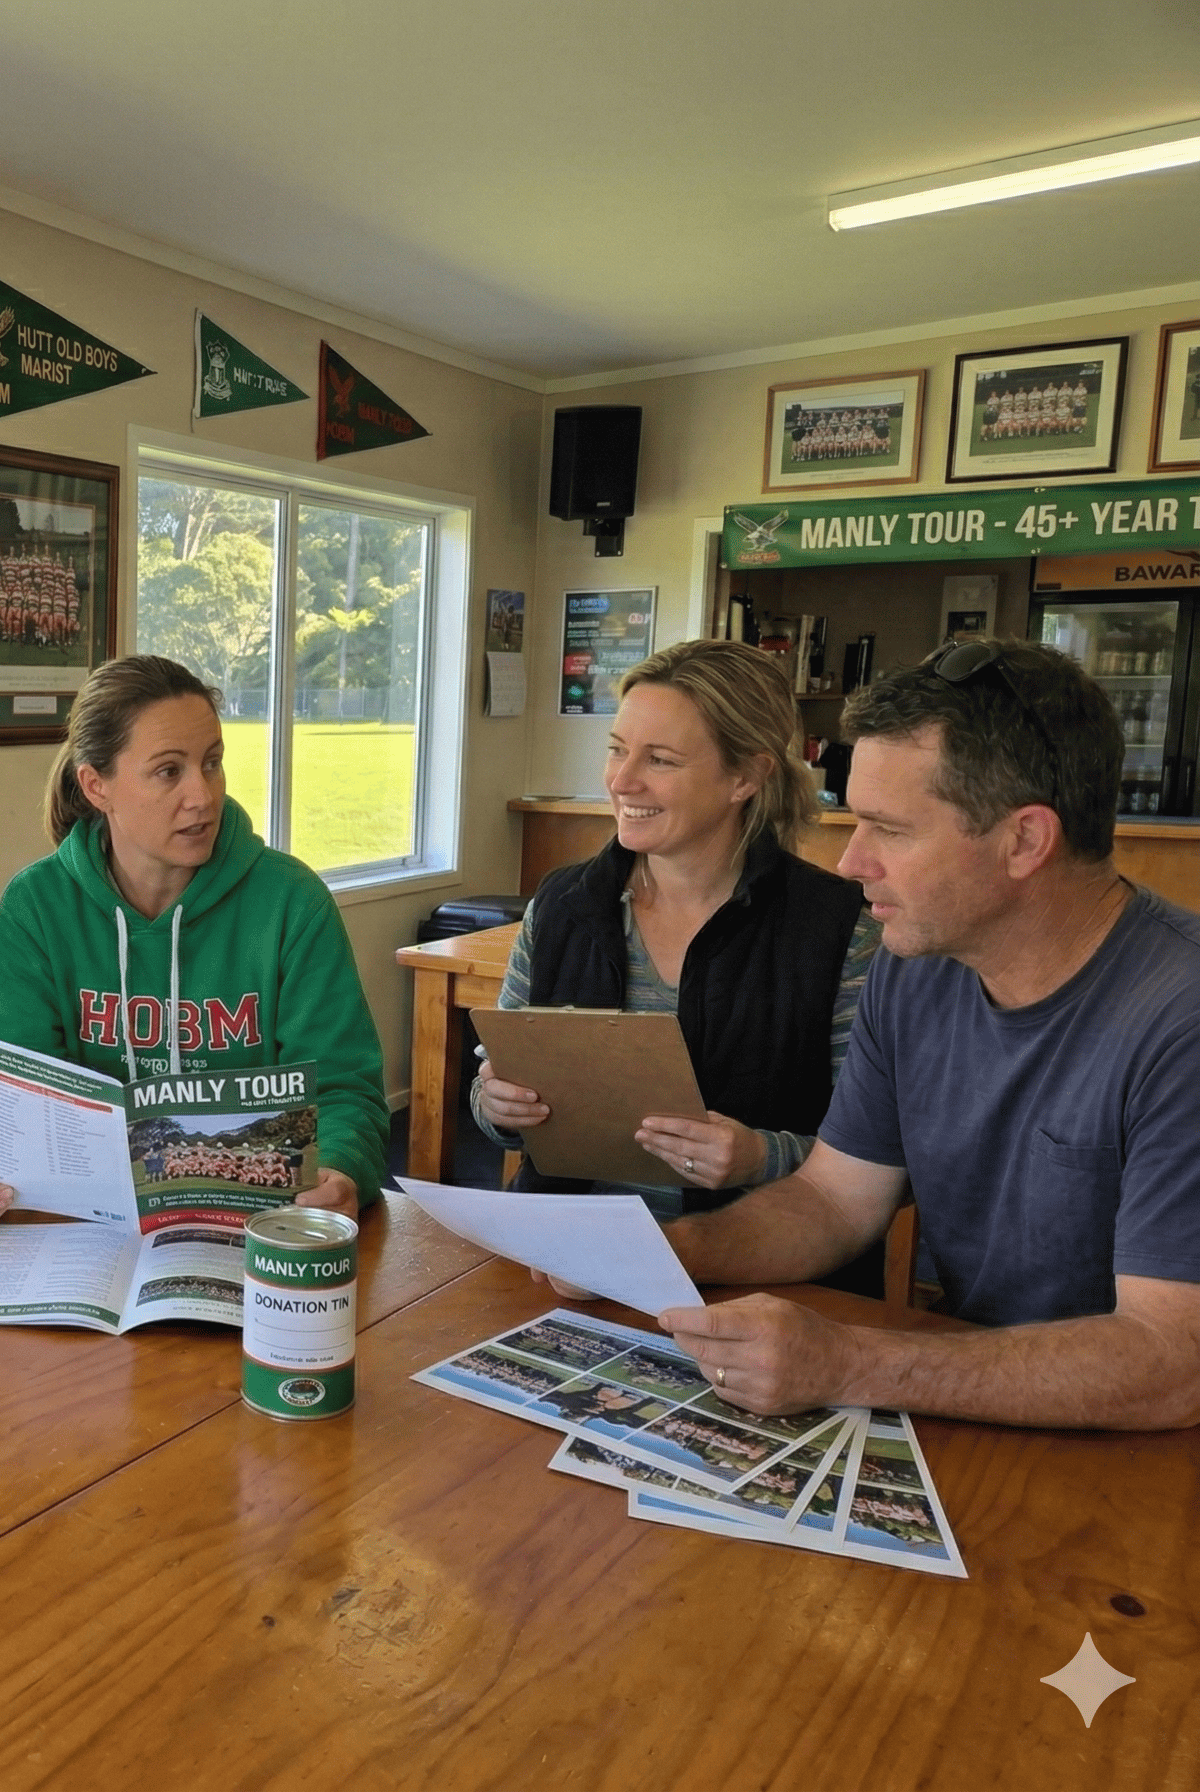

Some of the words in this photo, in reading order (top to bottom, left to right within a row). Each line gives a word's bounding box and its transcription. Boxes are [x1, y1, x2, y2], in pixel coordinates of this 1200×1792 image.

[18, 324, 53, 353] HUTT
[56, 336, 82, 362] OLD
[85, 345, 118, 372] BOYS
[21, 353, 72, 385] MARIST
[801, 514, 899, 549] MANLY
[907, 510, 985, 544] TOUR
[994, 520, 1007, 528] -
[1015, 504, 1079, 538] 45+
[1090, 498, 1179, 535] YEAR
[80, 988, 262, 1052] HOBM
[133, 1078, 226, 1109] MANLY
[234, 1071, 305, 1100] TOUR
[254, 1253, 308, 1278] MANLY
[311, 1258, 350, 1278] TOUR
[255, 1292, 328, 1314] DONATION
[331, 1296, 349, 1311] TIN
